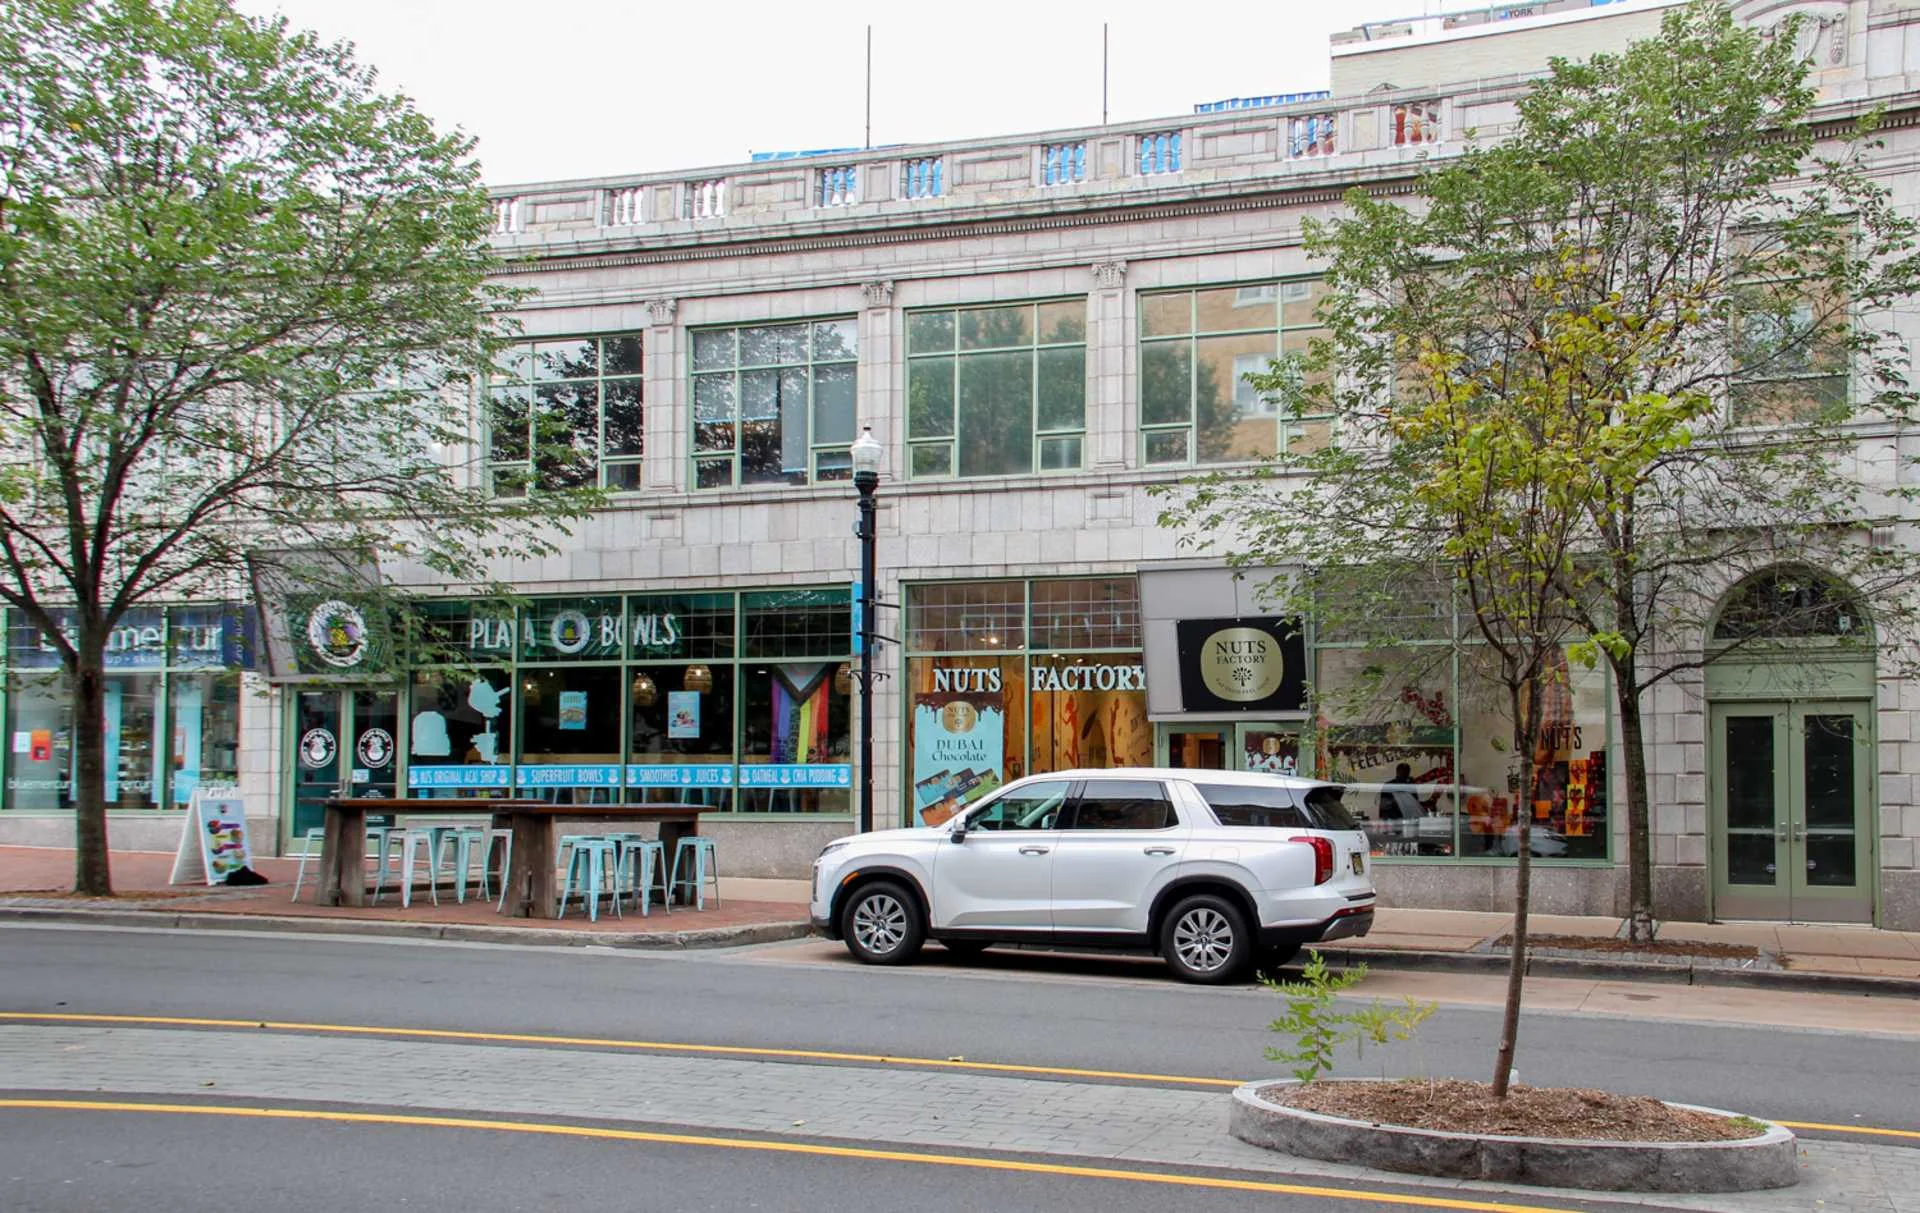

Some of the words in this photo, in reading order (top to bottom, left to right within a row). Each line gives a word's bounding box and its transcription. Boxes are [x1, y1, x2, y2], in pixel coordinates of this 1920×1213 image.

[1509, 8, 1533, 18] YORK
[471, 617, 536, 649] PLAA
[1216, 640, 1267, 655] NUTS
[1216, 655, 1266, 665] FACTORY
[933, 668, 1002, 693] NUTS
[1031, 665, 1147, 692] FACTORY
[947, 705, 970, 713] NUTS
[936, 738, 983, 750] DUBAI
[1541, 725, 1582, 751] NUTS
[931, 750, 987, 762] Chocolate
[531, 768, 575, 784] SUPERFRUIT
[577, 768, 603, 784] BOWLS
[639, 768, 678, 783] SMOOTHIES
[695, 768, 719, 783] JUICES
[752, 768, 778, 783] OATMEAL
